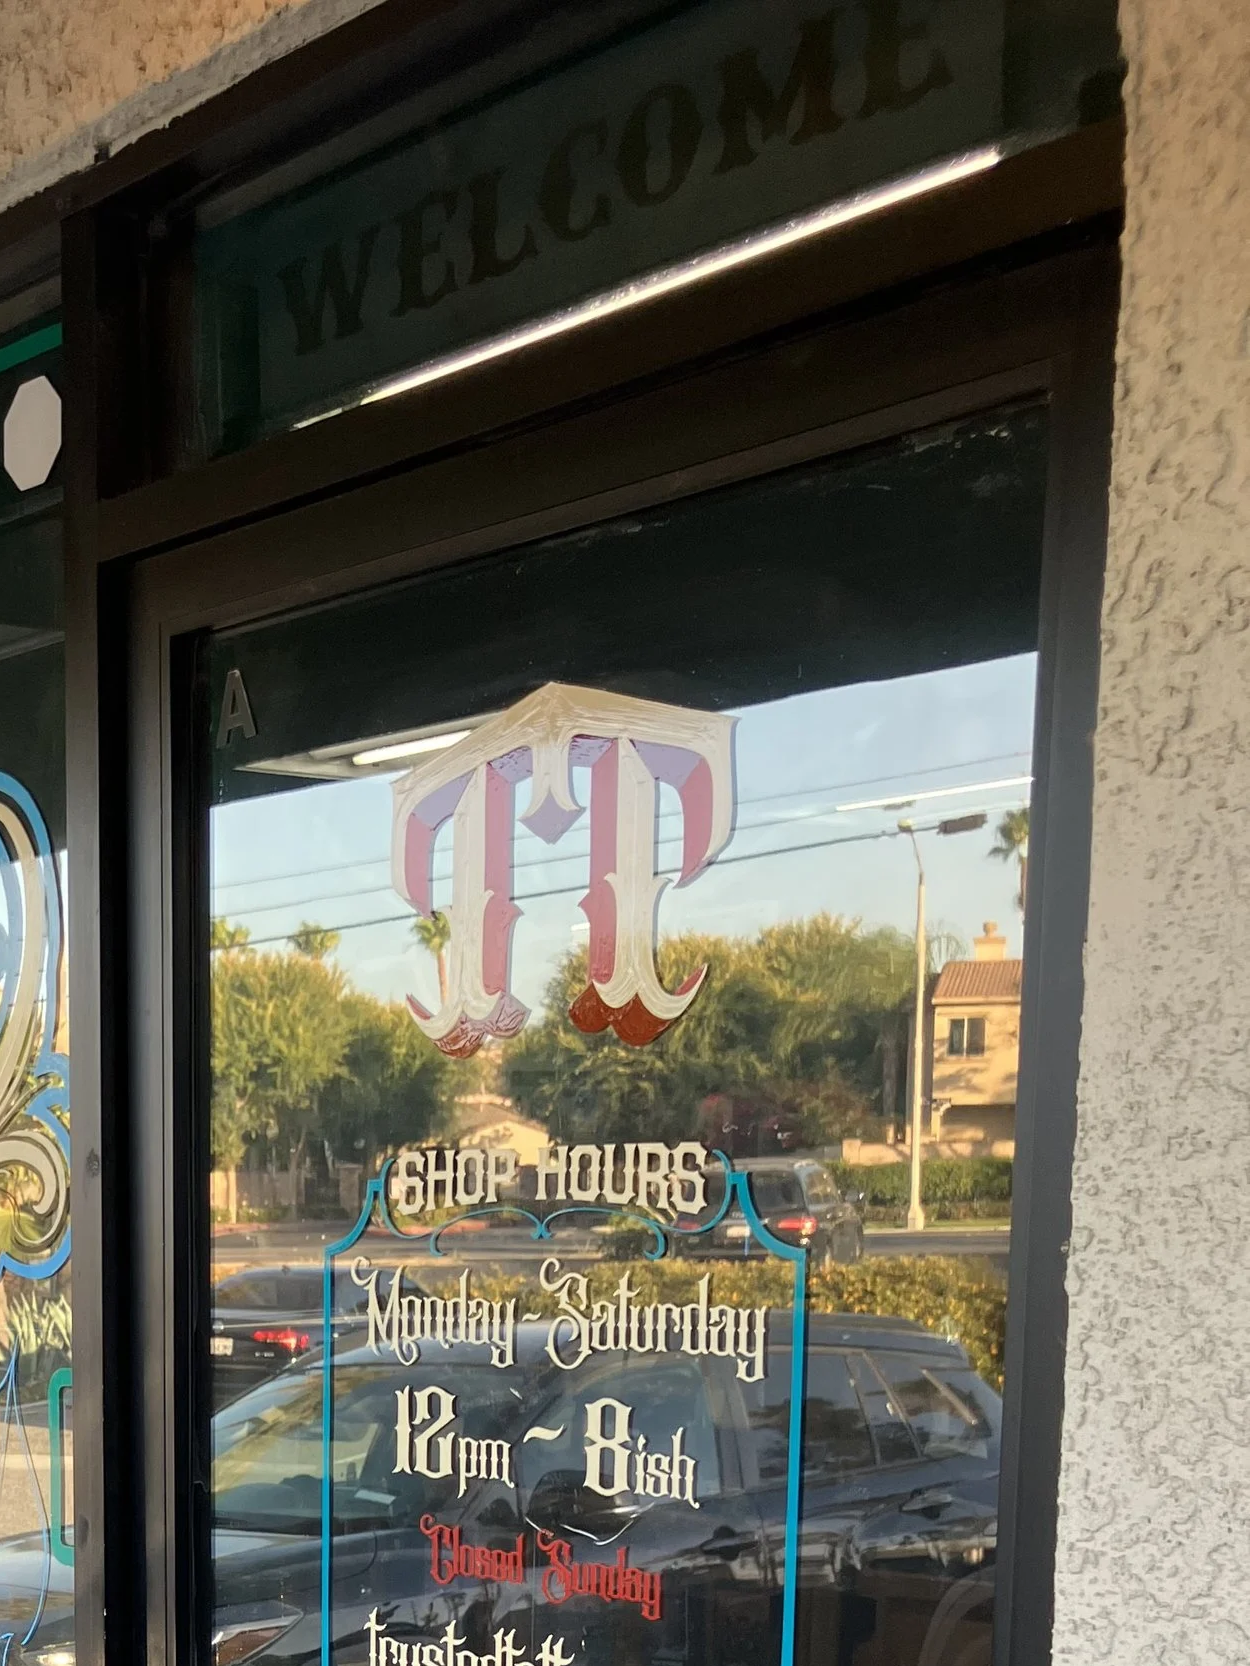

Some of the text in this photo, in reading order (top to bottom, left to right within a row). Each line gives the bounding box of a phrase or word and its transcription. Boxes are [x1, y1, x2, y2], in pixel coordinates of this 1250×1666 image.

[276, 0, 953, 357] WELCOME
[216, 669, 257, 750] A
[394, 1141, 709, 1215] SHOP HOURS
[391, 1385, 515, 1499] 12pm
[583, 1397, 701, 1510] 8ish
[420, 1515, 664, 1621] Closed Sunday
